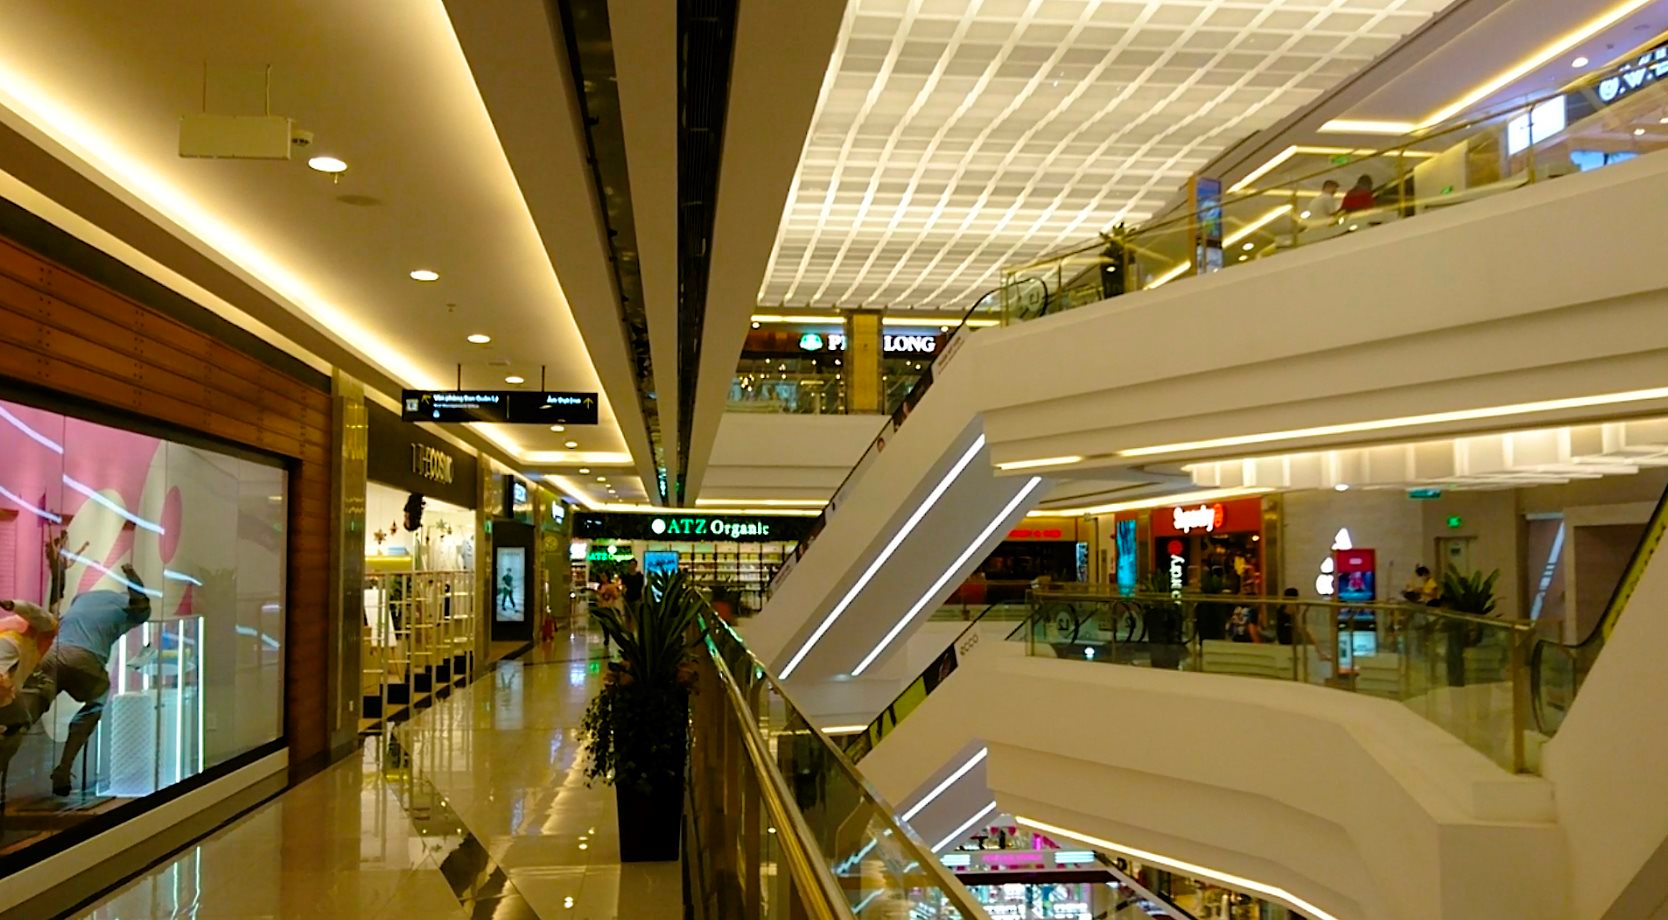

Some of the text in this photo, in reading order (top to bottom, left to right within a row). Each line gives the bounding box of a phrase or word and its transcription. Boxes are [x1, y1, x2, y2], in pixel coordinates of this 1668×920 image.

[883, 335, 936, 352] LONG
[667, 518, 770, 538] ATZ Organic
[588, 552, 608, 561] ATZ
